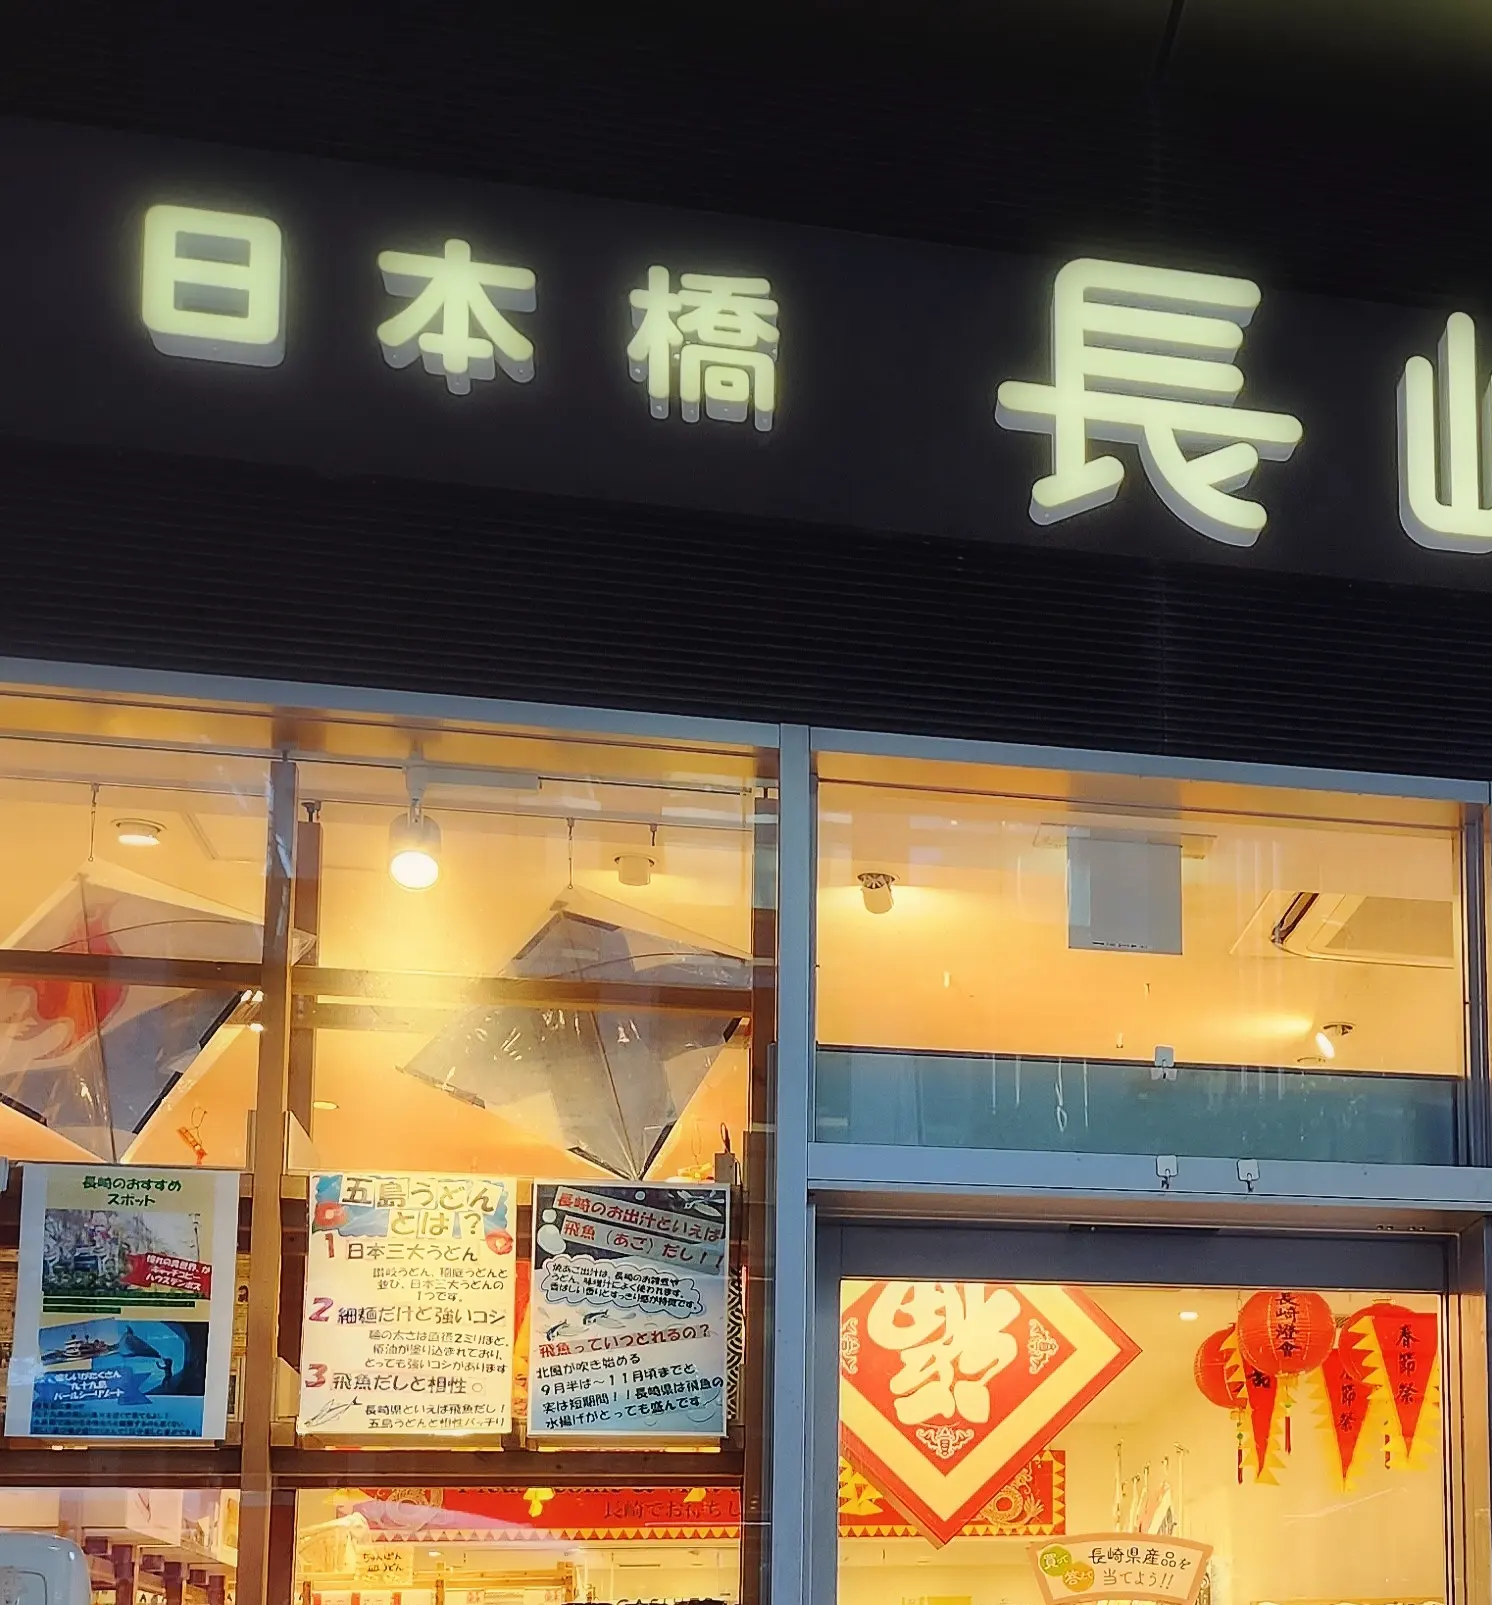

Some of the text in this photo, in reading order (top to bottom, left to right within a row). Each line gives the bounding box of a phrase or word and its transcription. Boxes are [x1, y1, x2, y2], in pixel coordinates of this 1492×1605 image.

[140, 203, 784, 428] 日本橋
[83, 1176, 182, 1192] 長崎のおすすめ
[342, 1177, 496, 1212] 五島うどん
[108, 1194, 155, 1206] スポット
[391, 1211, 482, 1235] とは?
[557, 1192, 724, 1242] 長崎のお出汁といえば
[325, 1232, 478, 1261] 1 日本三大うどん
[309, 1297, 506, 1325] 2 細麺だけど強いコシ
[539, 1324, 710, 1358] 飛魚っていつとれるの?
[305, 1363, 328, 1388] 3
[536, 1354, 641, 1380] 北風が吹き始める
[1396, 1323, 1420, 1404] 春節祭
[545, 1396, 701, 1429] 水揚げがとっても盛んです
[1340, 1369, 1357, 1433] 節祭
[1088, 1546, 1192, 1571] 長崎県産品を
[1103, 1567, 1175, 1590] 当てよう!!
